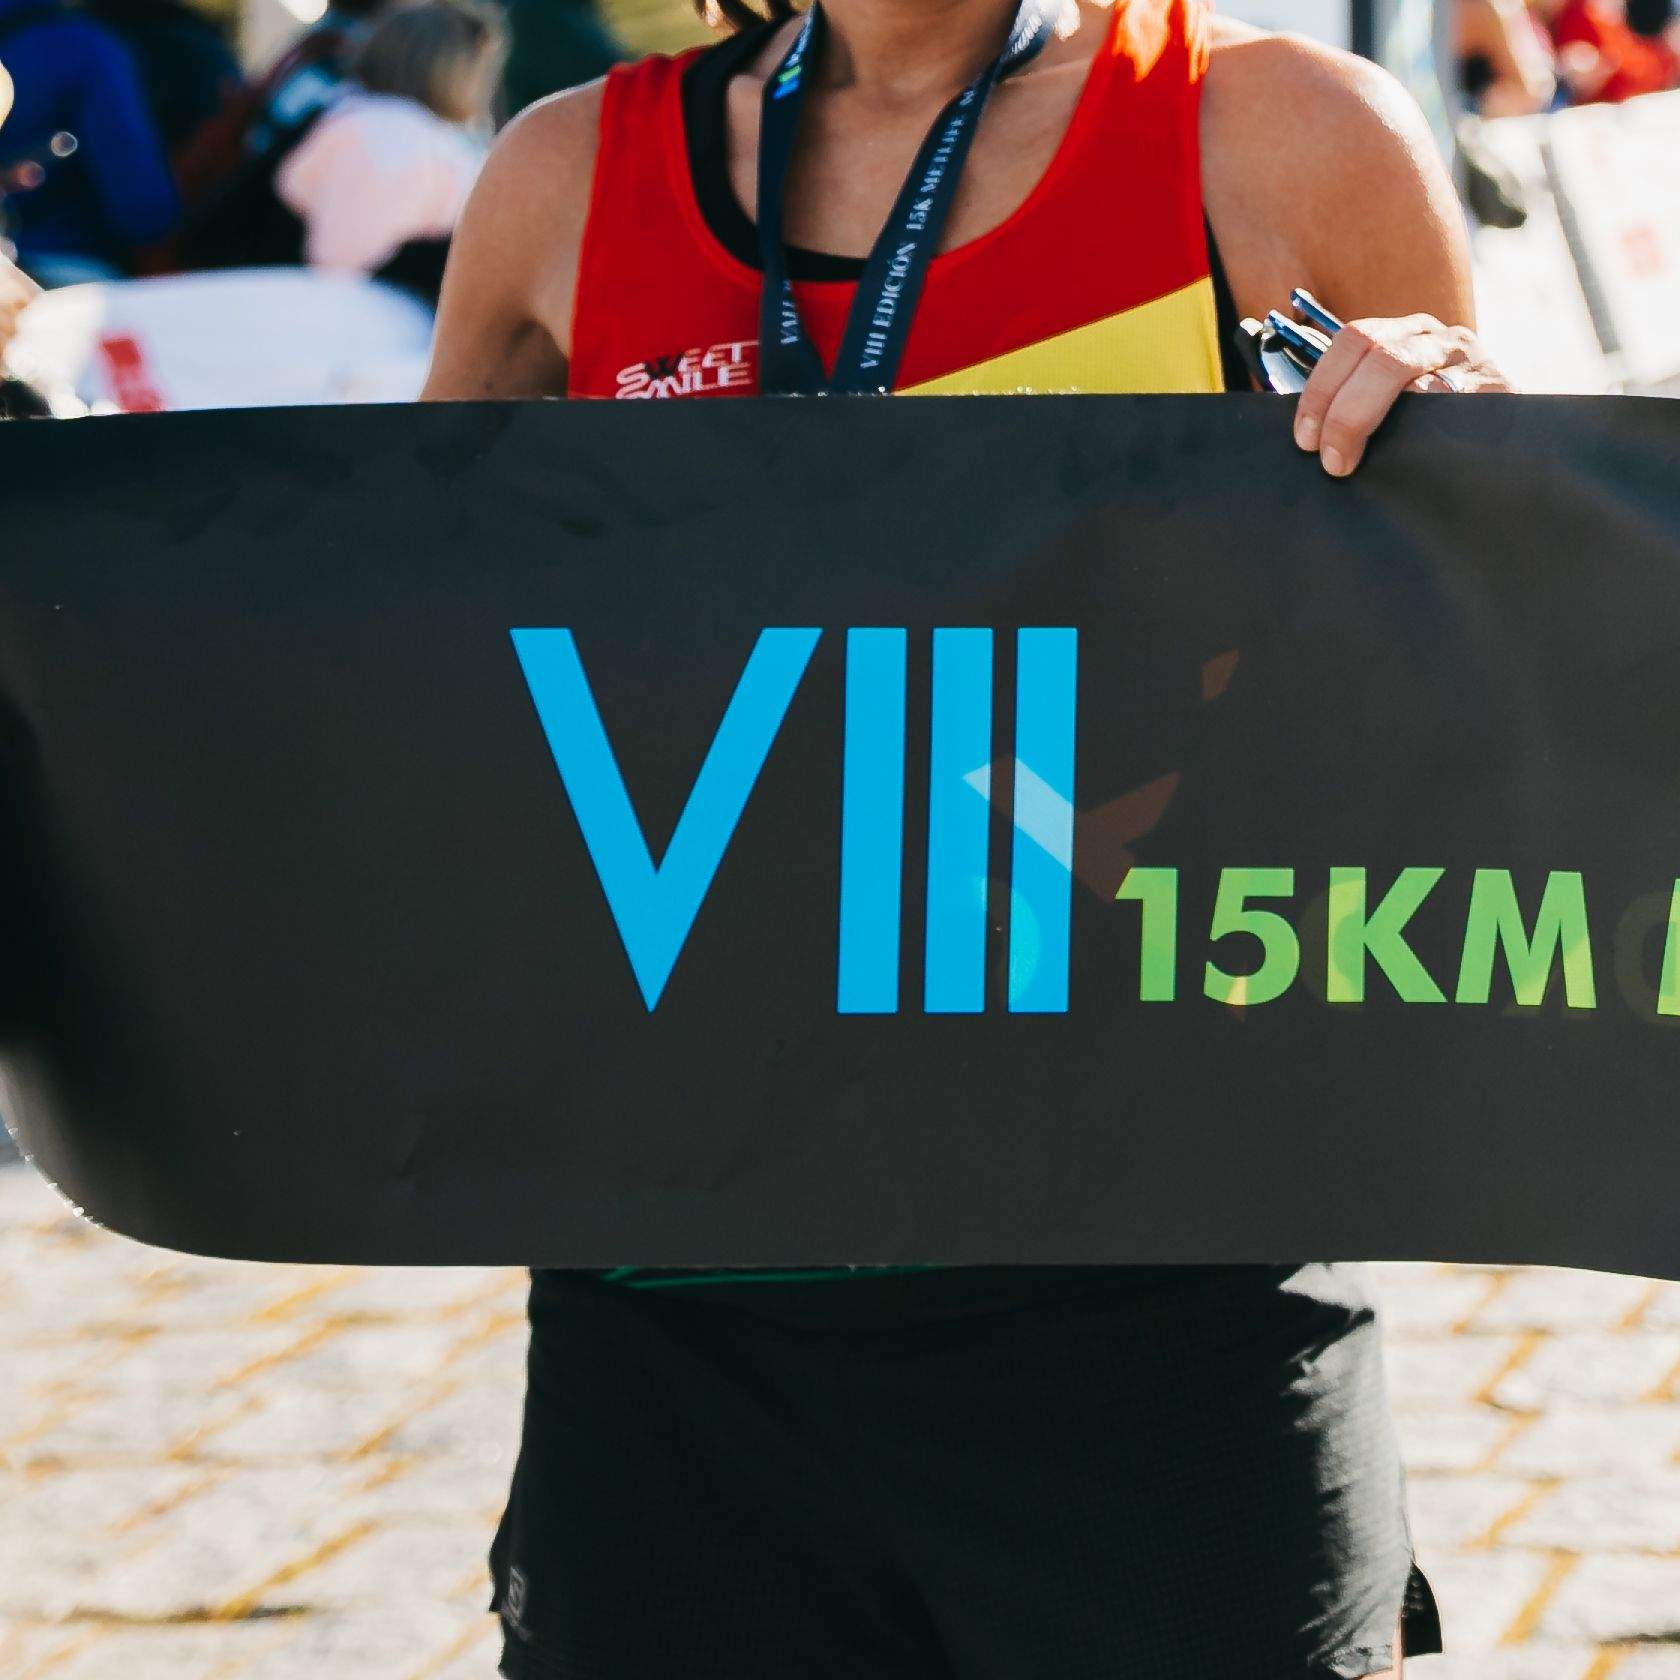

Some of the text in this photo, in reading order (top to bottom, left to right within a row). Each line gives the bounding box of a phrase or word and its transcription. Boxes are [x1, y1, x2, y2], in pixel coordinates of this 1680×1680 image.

[615, 339, 761, 386] SWEET
[860, 329, 886, 370] VIII
[873, 240, 917, 329] EDICIÓN
[906, 196, 934, 231] 15K
[509, 626, 1078, 1014] VIII
[1115, 866, 1598, 1010] 15KM
